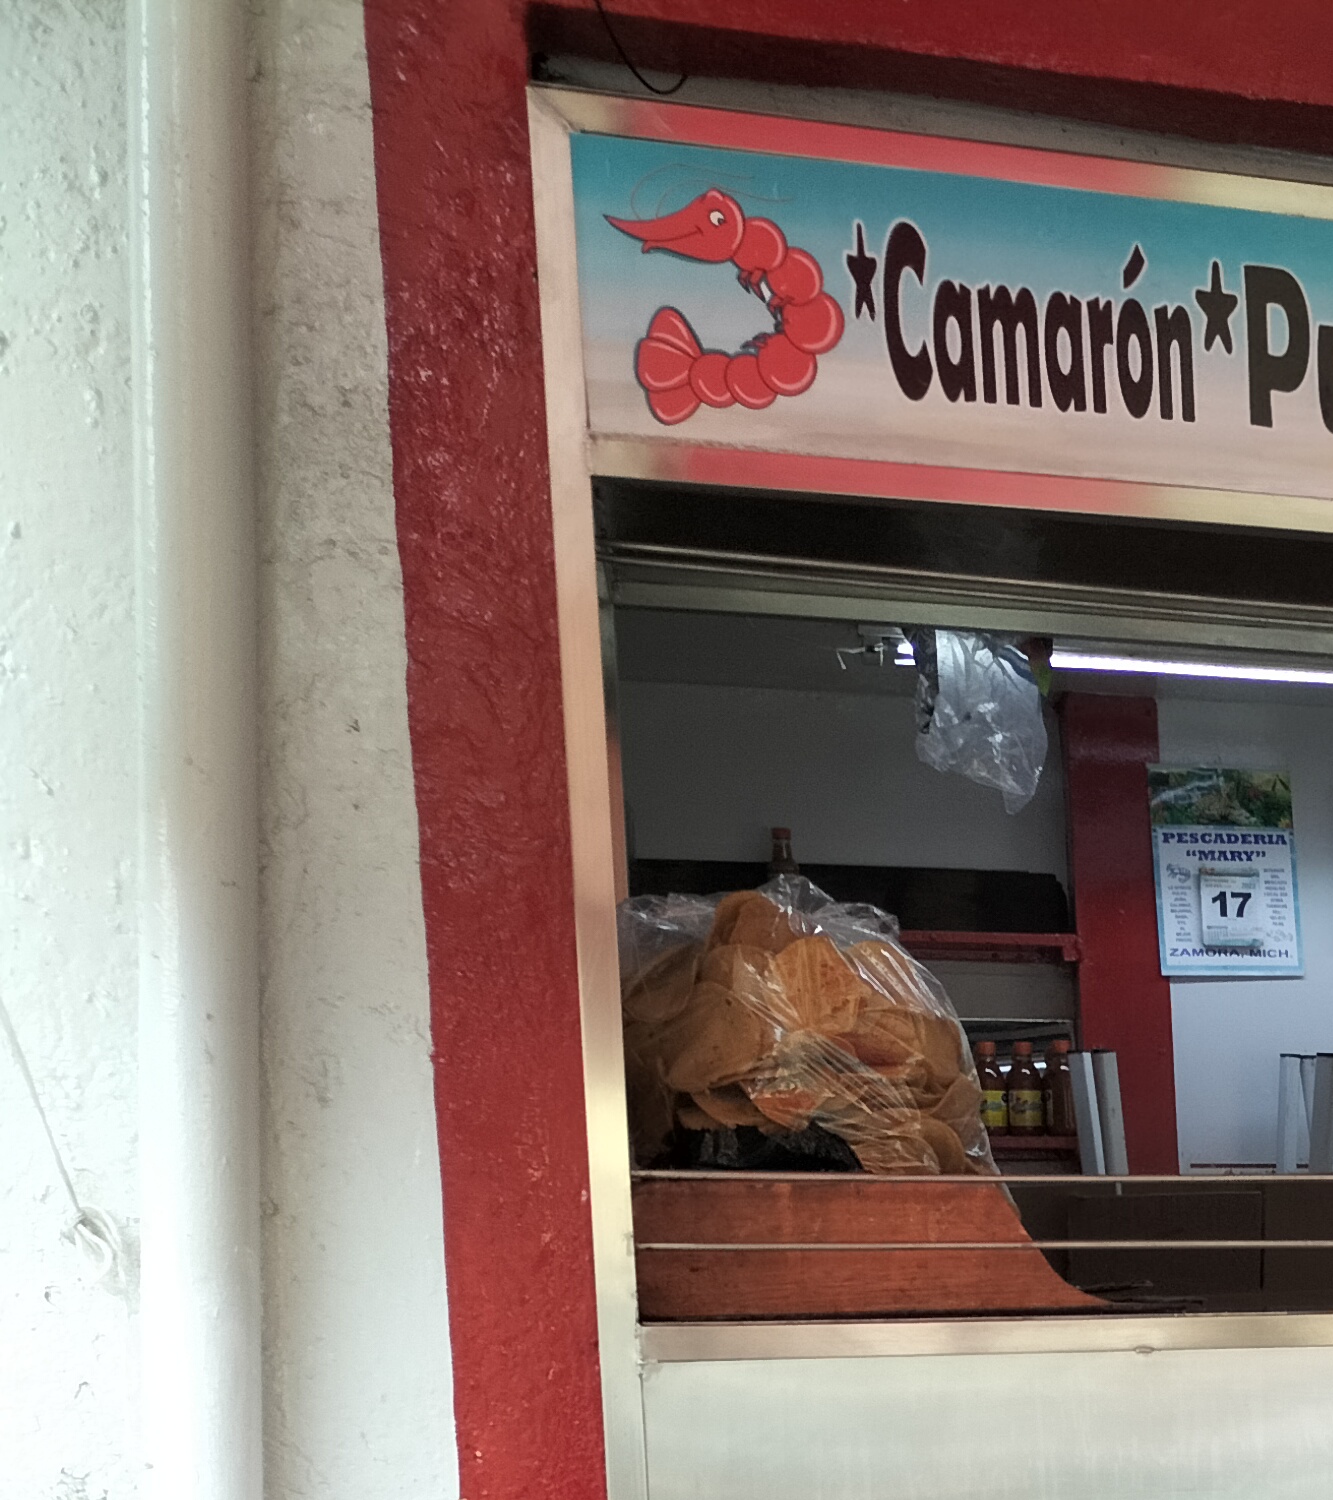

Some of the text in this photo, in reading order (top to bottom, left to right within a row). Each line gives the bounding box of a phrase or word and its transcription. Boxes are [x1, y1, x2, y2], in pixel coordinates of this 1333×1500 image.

[881, 221, 1197, 422] Camarón
[1162, 832, 1288, 845] PESCADERIA
[1212, 891, 1252, 918] 17
